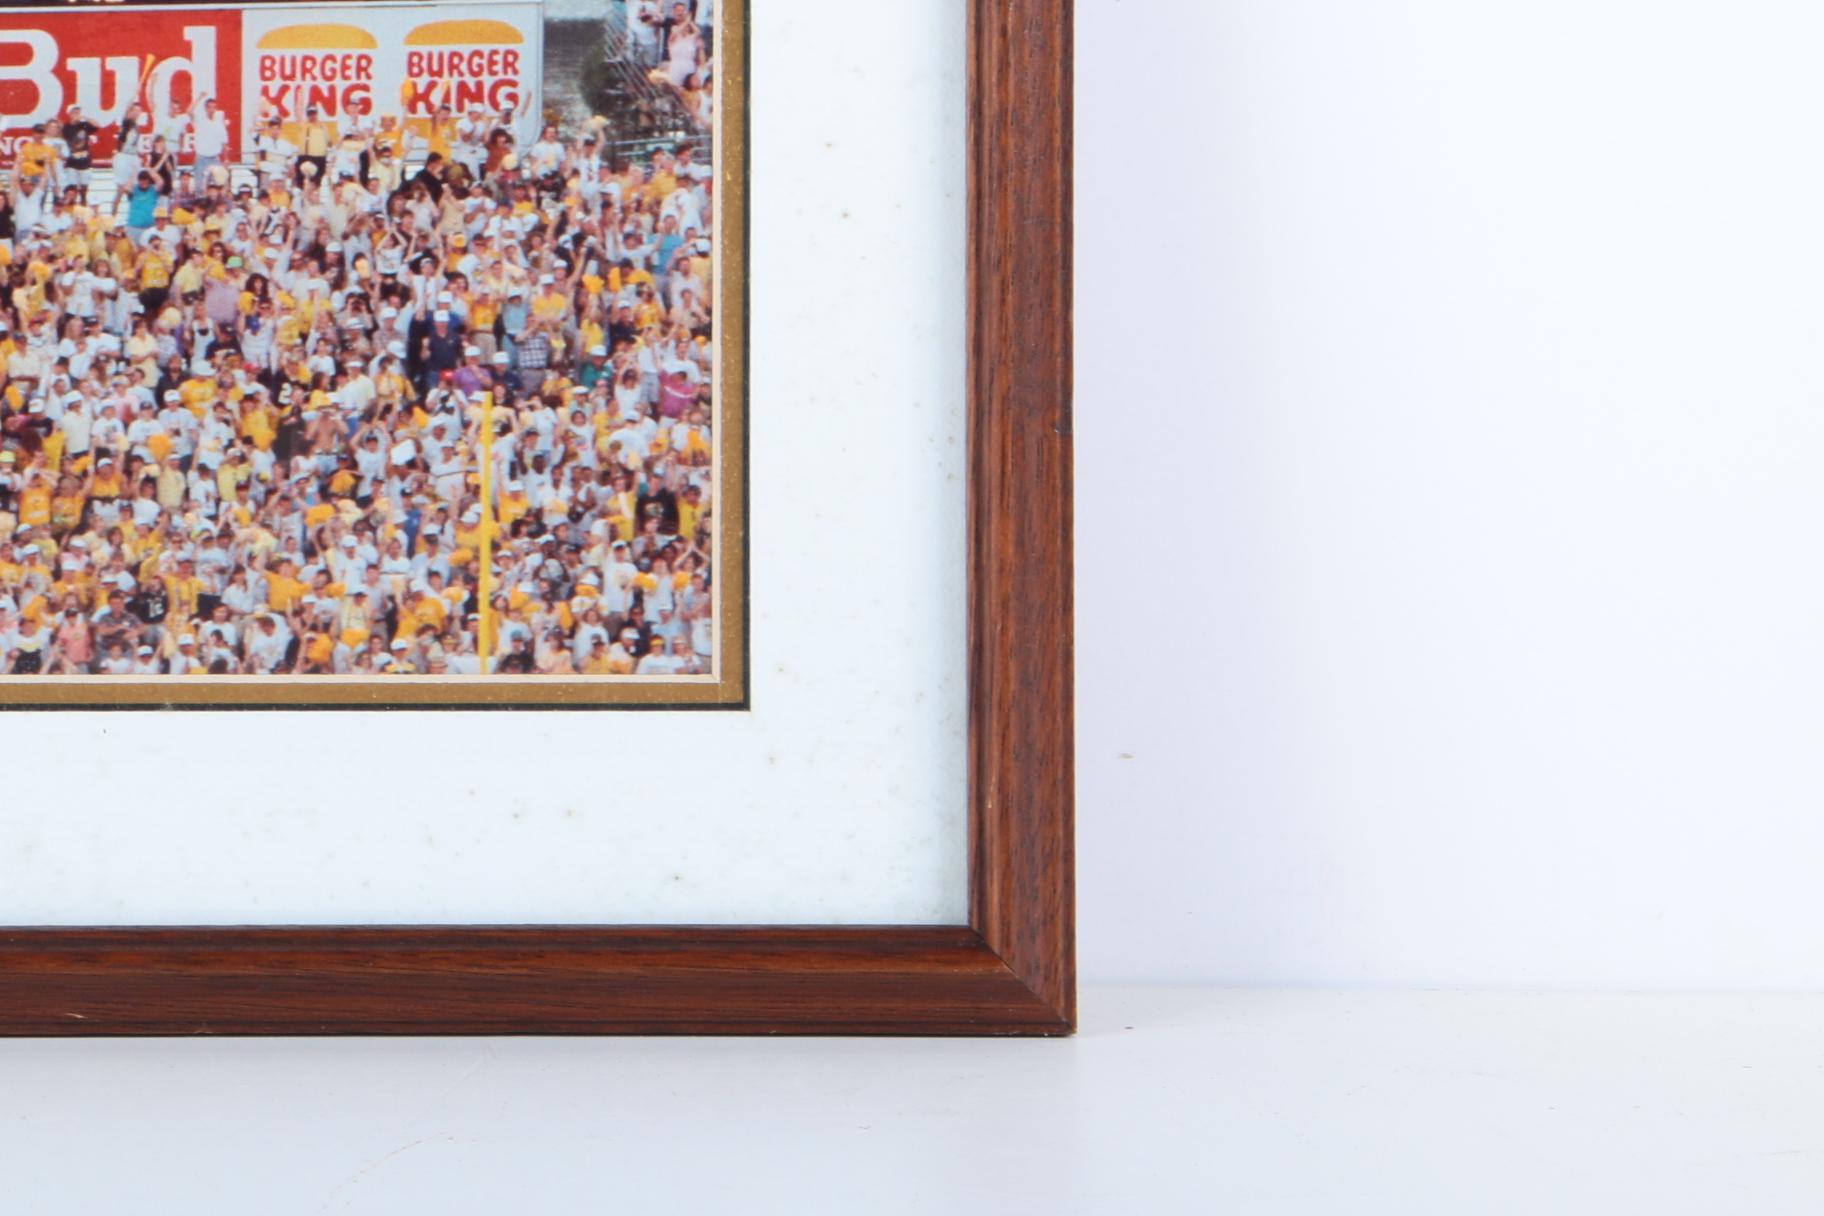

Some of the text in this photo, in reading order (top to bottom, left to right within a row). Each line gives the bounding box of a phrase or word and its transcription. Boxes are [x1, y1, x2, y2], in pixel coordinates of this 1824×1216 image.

[259, 53, 374, 82] BURGER
[406, 48, 521, 78] BURGER
[260, 82, 373, 118] KNG
